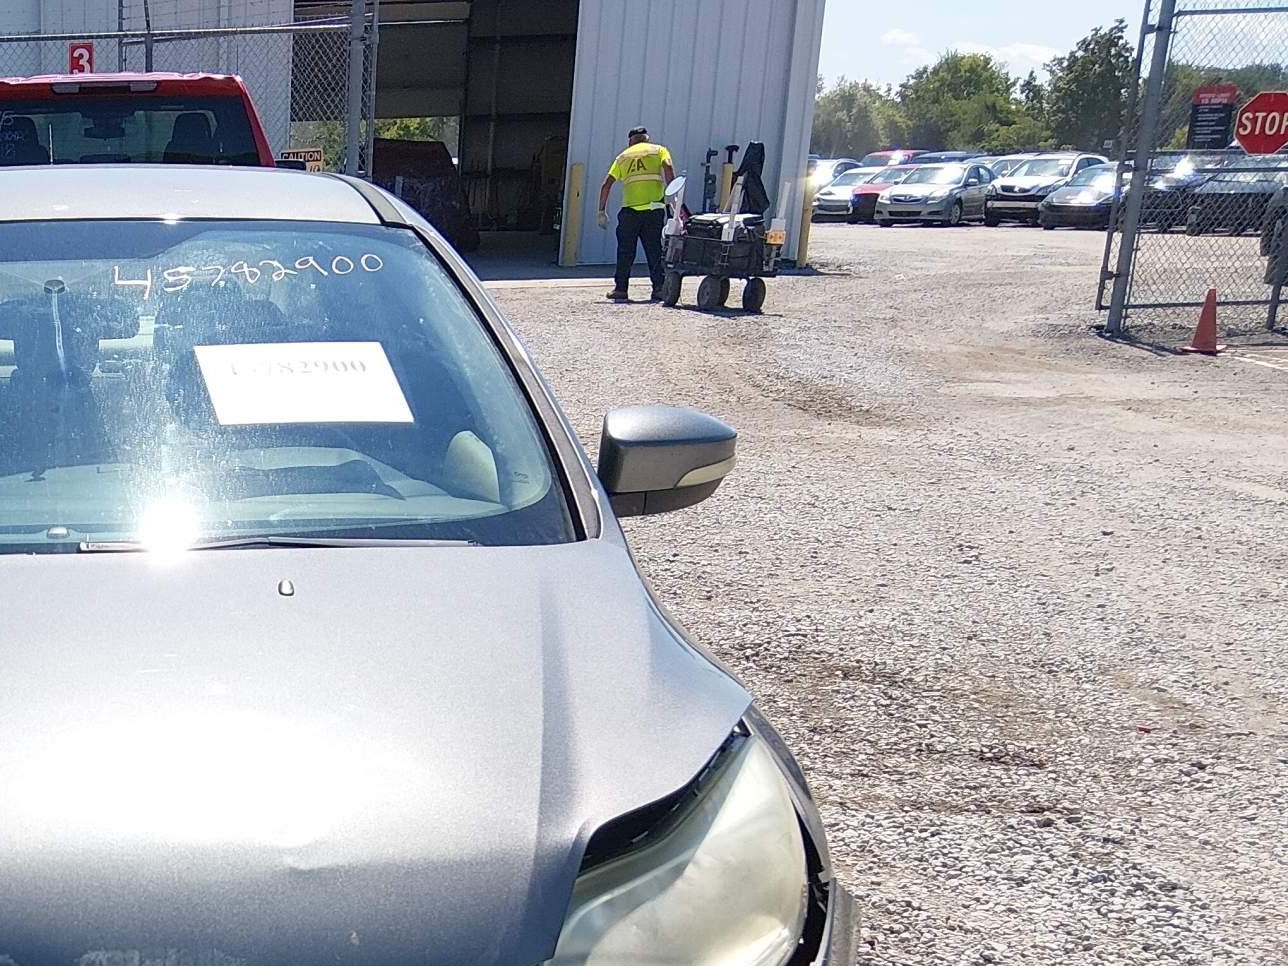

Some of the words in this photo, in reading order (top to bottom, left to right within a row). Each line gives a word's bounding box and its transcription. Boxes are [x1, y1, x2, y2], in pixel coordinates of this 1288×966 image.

[73, 48, 90, 73] 3
[283, 151, 321, 161] CAUTION
[114, 254, 384, 301] 45782900
